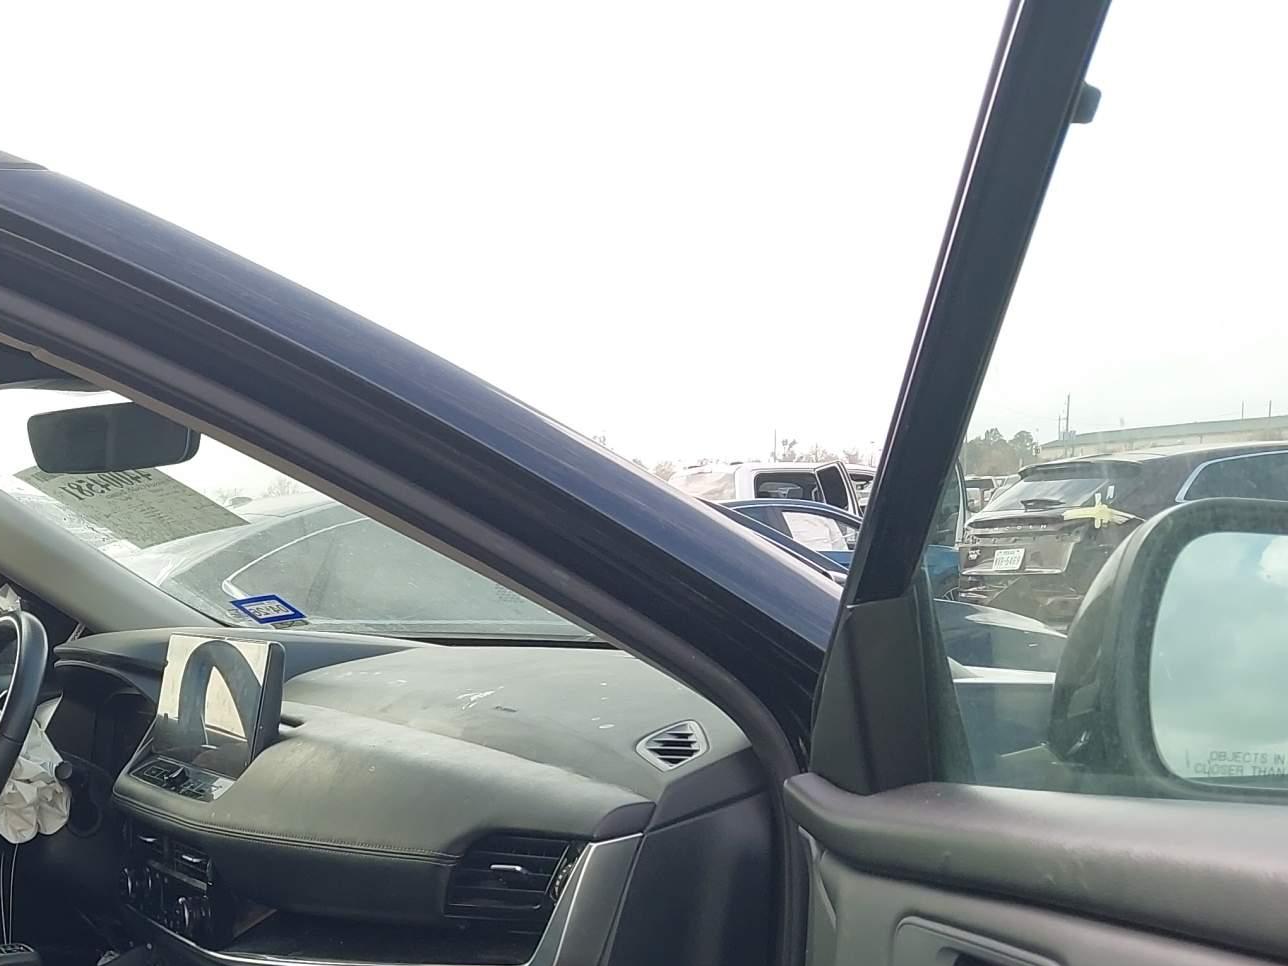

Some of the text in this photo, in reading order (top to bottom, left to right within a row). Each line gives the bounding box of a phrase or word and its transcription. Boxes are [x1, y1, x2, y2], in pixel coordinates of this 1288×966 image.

[1209, 750, 1286, 765] OBJECTS IN
[1193, 762, 1287, 776] CLOSER THAN
